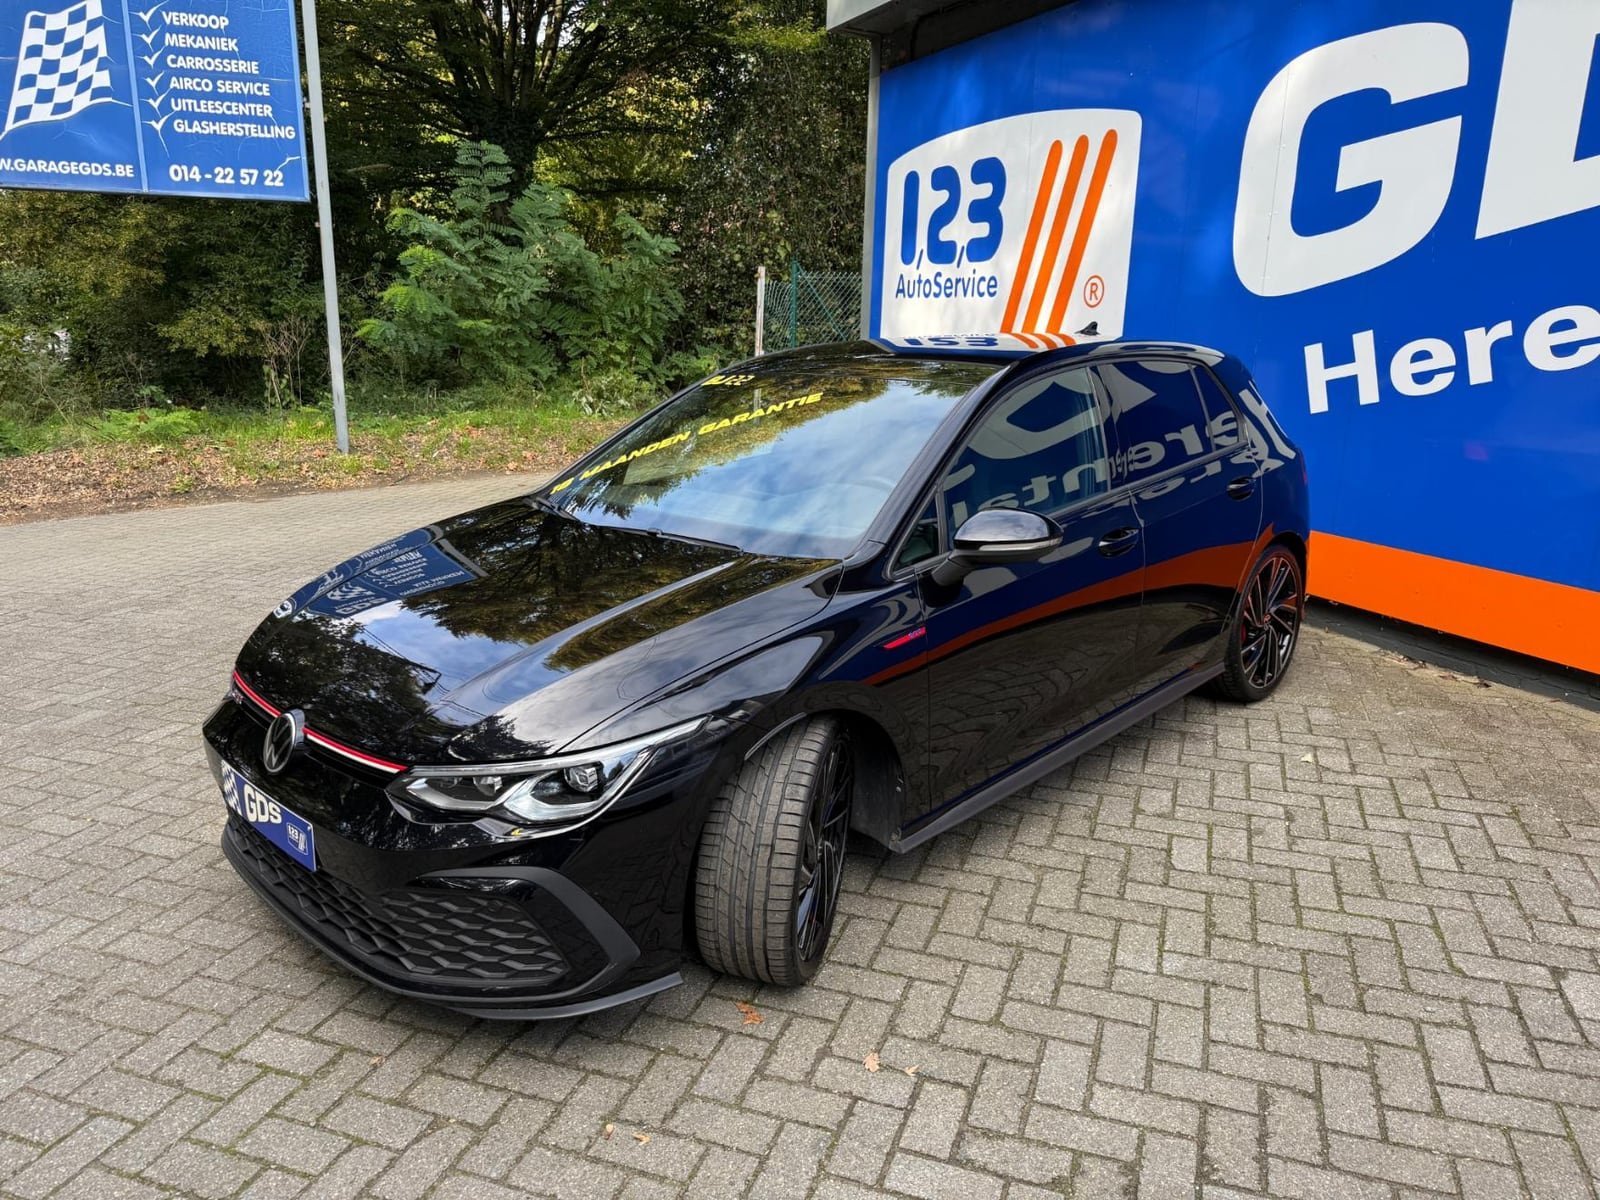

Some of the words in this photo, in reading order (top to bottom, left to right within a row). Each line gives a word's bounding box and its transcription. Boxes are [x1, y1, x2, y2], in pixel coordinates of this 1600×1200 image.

[162, 11, 229, 30] VERKOOP
[165, 33, 238, 52] MEKANIEK
[166, 55, 259, 75] CARROSSERIE
[169, 76, 213, 92] AIRCO
[216, 79, 270, 97] SERVICE
[171, 98, 272, 118] UITLEESCENTER
[173, 119, 296, 140] GLASHERSTELLING
[169, 164, 201, 182] 014
[214, 168, 235, 185] 22
[239, 169, 258, 186] 57
[263, 170, 284, 187] 22
[895, 269, 998, 299] AutoService
[1304, 304, 1600, 414] Here
[579, 431, 691, 481] MAANDEN
[698, 392, 824, 436] GARANTIE
[243, 784, 282, 825] GDS
